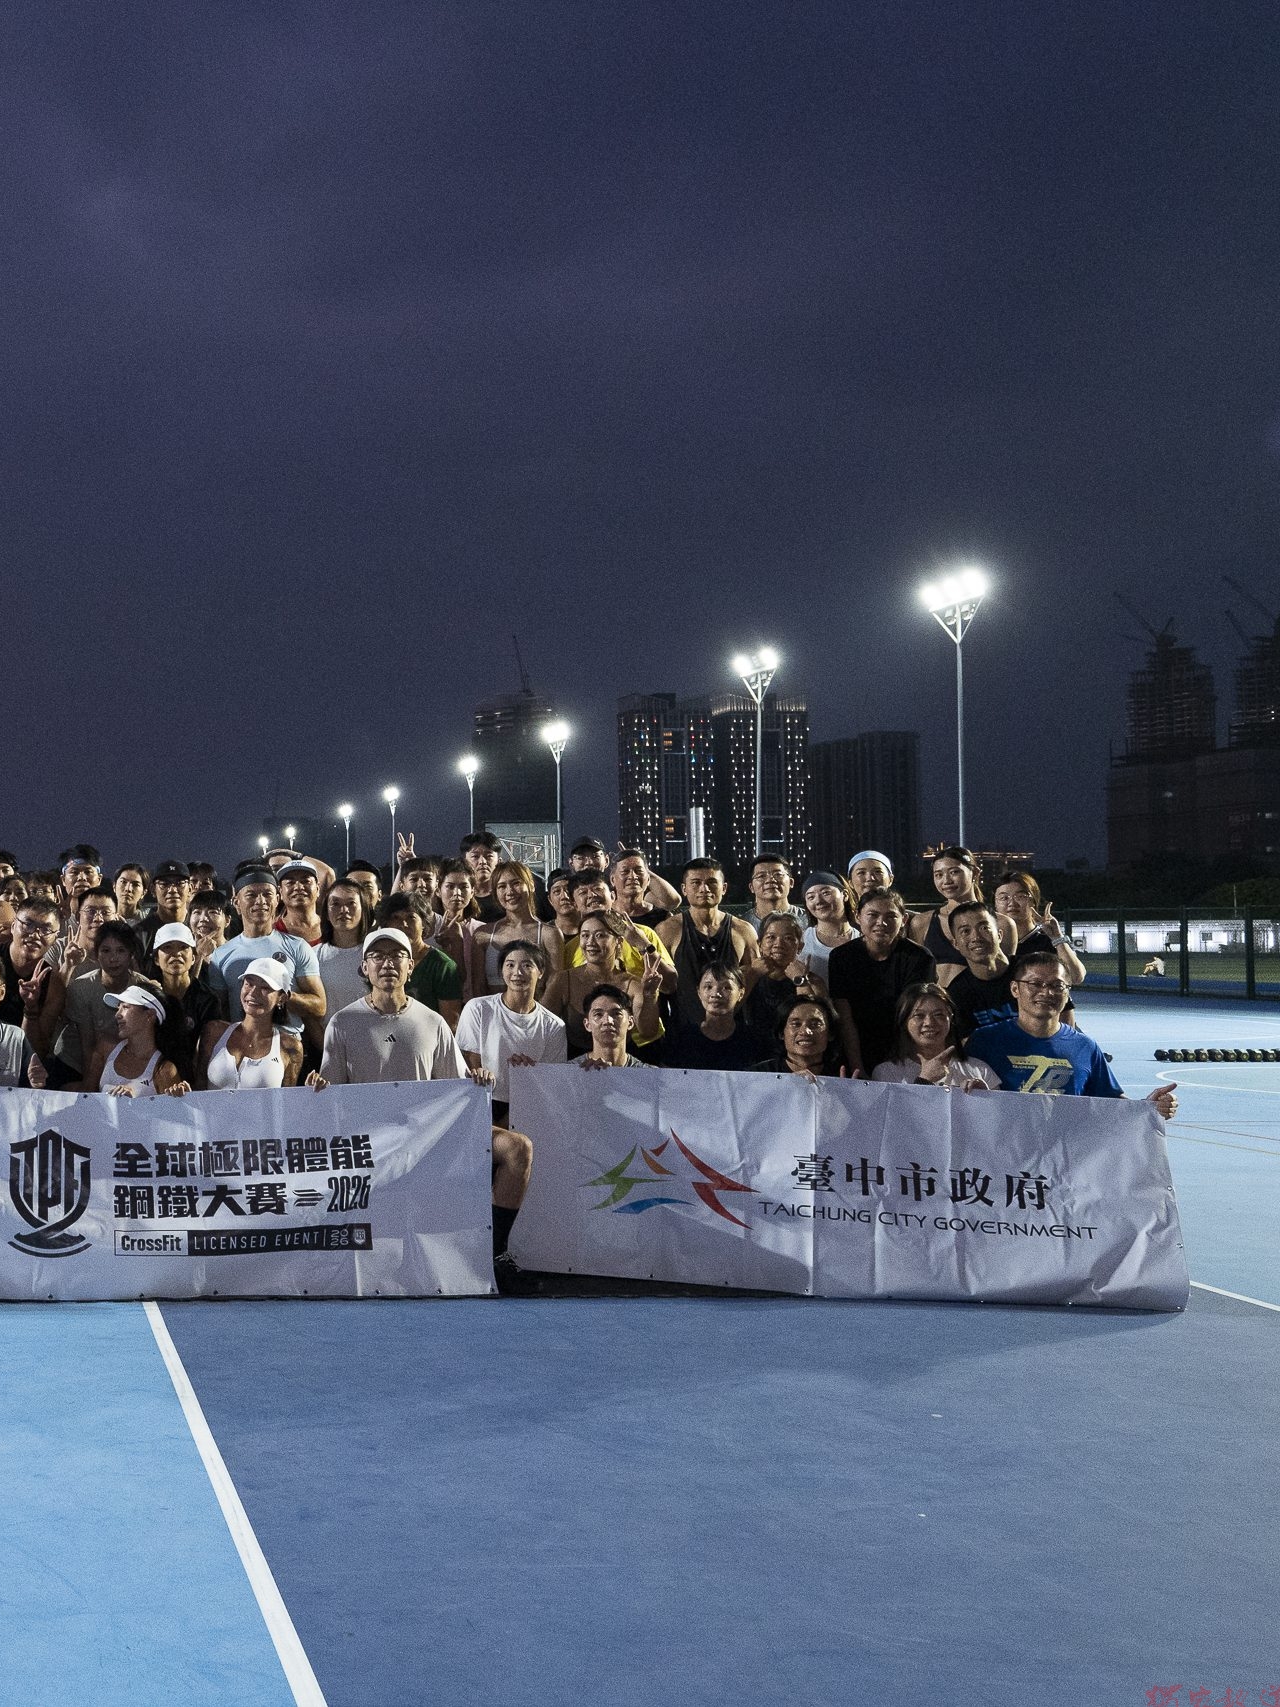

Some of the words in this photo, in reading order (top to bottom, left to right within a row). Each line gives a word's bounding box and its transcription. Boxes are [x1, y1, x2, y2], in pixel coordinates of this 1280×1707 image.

[113, 1134, 375, 1178] 全球極限體能
[113, 1182, 289, 1219] 鋼鐵大賽
[326, 1174, 372, 1213] 2026
[791, 1153, 1051, 1211] 臺中市政府
[330, 1229, 349, 1238] 20
[758, 1202, 871, 1223] TAICHUNG
[878, 1211, 928, 1229] CITY
[933, 1217, 1098, 1240] GOVERNMENT
[121, 1234, 182, 1252] CrossFit
[194, 1235, 267, 1251] LICENSED
[275, 1231, 319, 1247] EVENT
[330, 1237, 349, 1246] 26
